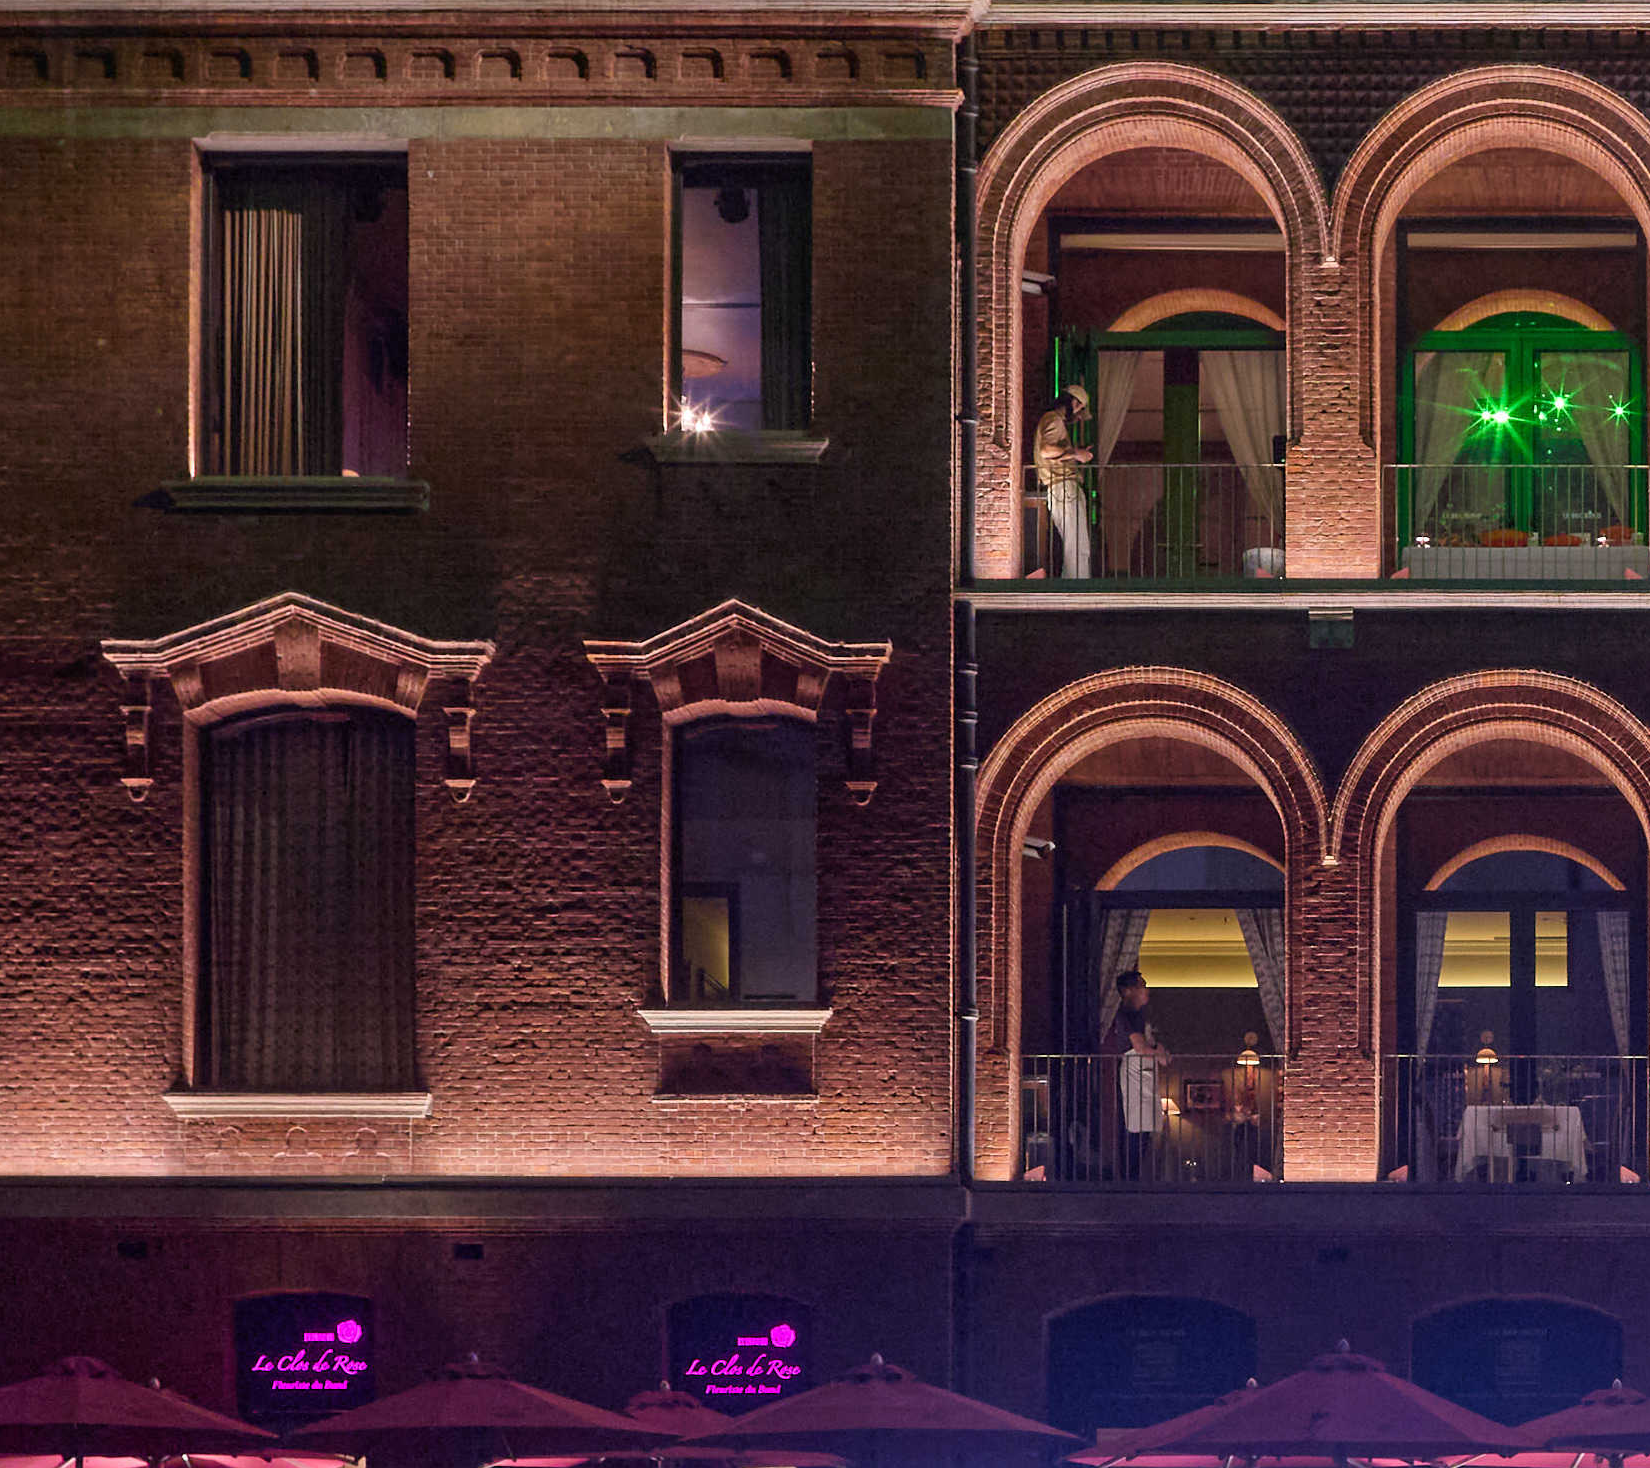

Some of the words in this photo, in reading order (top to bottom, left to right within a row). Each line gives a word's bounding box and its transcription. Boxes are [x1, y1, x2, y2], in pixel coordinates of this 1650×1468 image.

[251, 1354, 275, 1372] Le
[312, 1348, 334, 1373] de
[333, 1355, 368, 1375] Rose
[685, 1358, 708, 1376] Le
[746, 1353, 767, 1377] de
[766, 1359, 802, 1380] Rose
